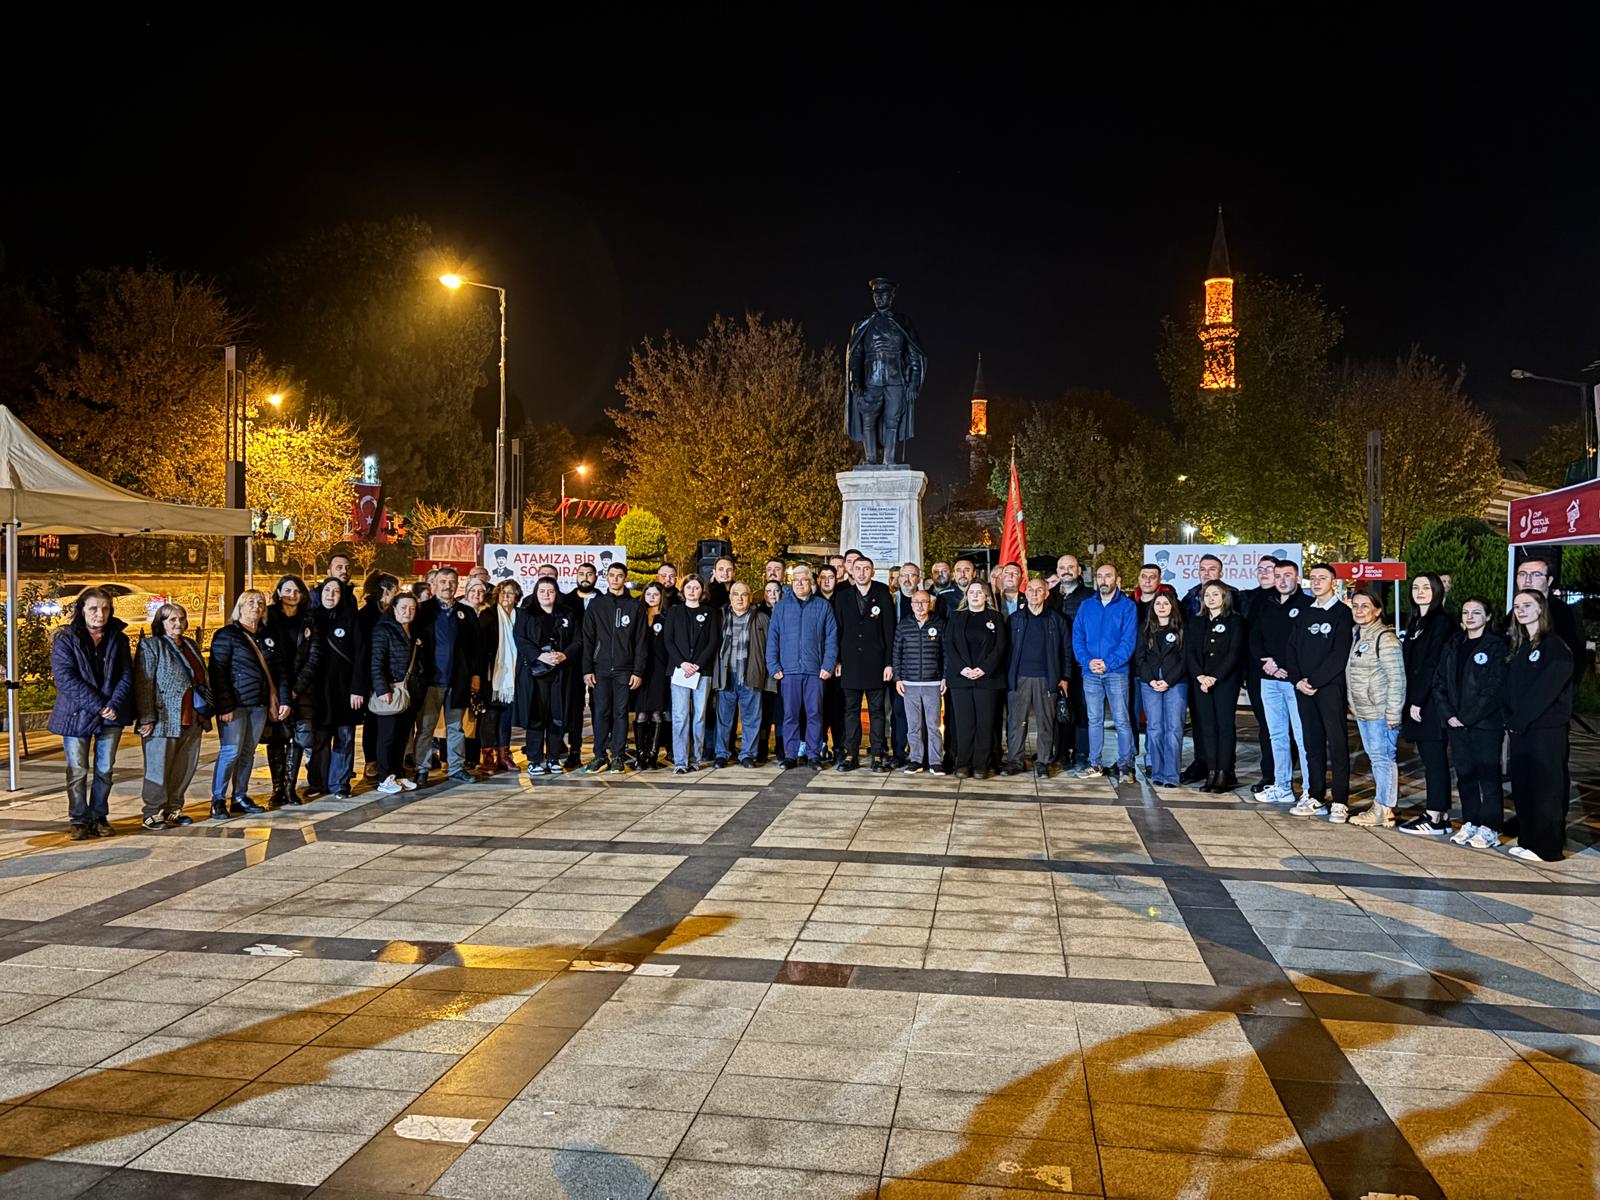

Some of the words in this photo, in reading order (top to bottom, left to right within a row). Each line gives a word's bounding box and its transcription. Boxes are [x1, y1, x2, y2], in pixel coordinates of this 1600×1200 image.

[513, 553, 571, 564] ATAMIZA
[574, 551, 595, 564] BİR
[1175, 553, 1239, 566] ATAZA
[520, 563, 540, 577] SÖ
[1182, 565, 1200, 579] SÖ
[1222, 568, 1257, 579] IRAK
